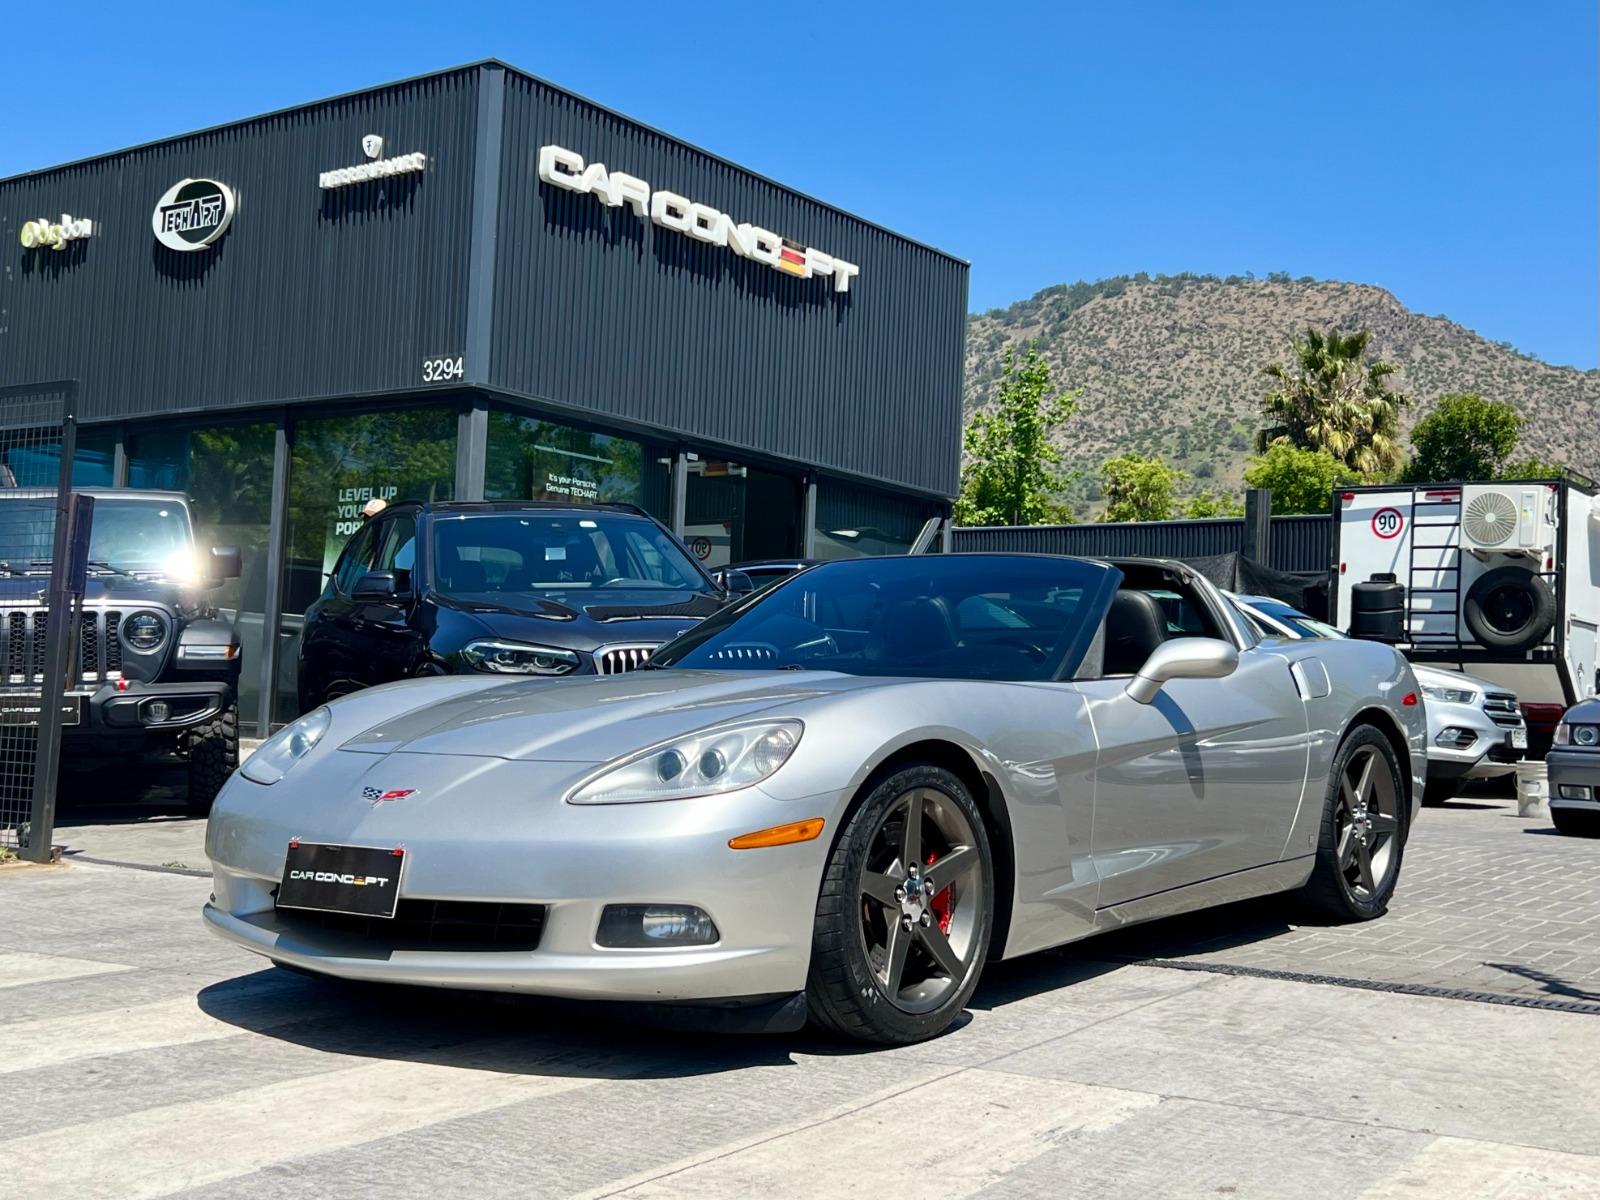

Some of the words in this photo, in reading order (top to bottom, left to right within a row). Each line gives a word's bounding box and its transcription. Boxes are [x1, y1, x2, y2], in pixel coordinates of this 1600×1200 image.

[539, 145, 650, 217] CAR
[651, 190, 860, 293] CONCEPT
[423, 357, 464, 381] 3294
[558, 476, 572, 485] your
[339, 487, 376, 502] LEVEL
[379, 486, 398, 500] UP
[546, 483, 570, 495] Genuine
[570, 486, 598, 500] TECHART
[1378, 514, 1397, 531] 90
[290, 870, 315, 881] CAR
[315, 871, 389, 888] CONCEPT
